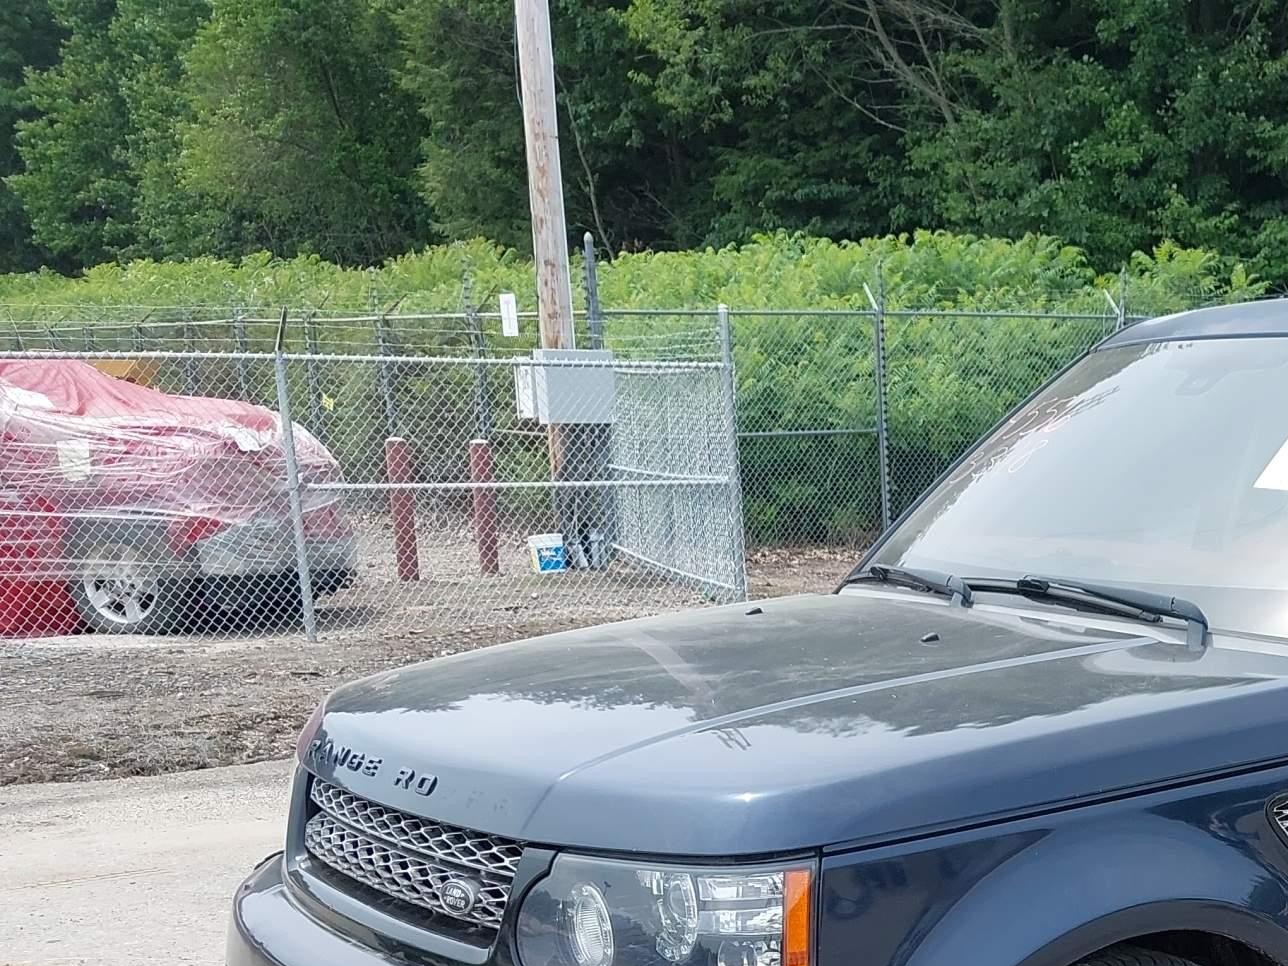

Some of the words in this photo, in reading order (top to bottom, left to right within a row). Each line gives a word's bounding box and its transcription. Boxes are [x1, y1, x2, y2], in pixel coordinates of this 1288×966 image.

[307, 737, 384, 778] RANGE
[445, 885, 463, 899] LAND
[446, 894, 466, 910] ROVER
